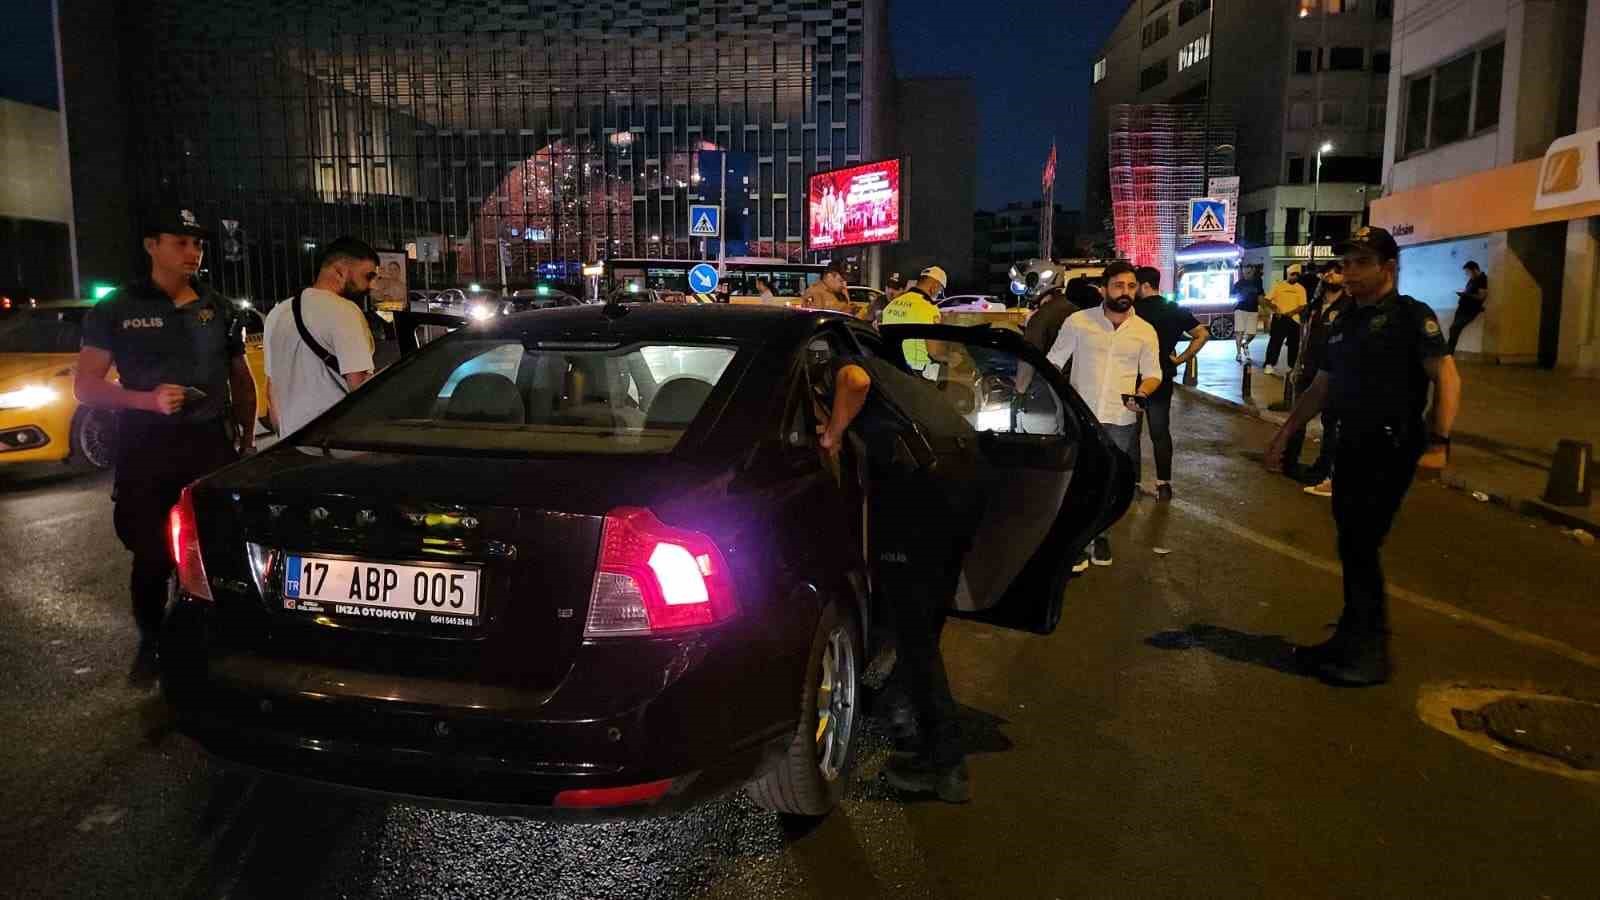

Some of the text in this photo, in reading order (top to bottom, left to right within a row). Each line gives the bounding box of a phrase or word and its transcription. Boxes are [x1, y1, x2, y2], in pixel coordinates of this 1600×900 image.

[122, 317, 165, 329] POLIS
[287, 580, 300, 592] TR
[303, 562, 465, 609] 17 ABP 005
[361, 607, 416, 621] OTOMOTIV
